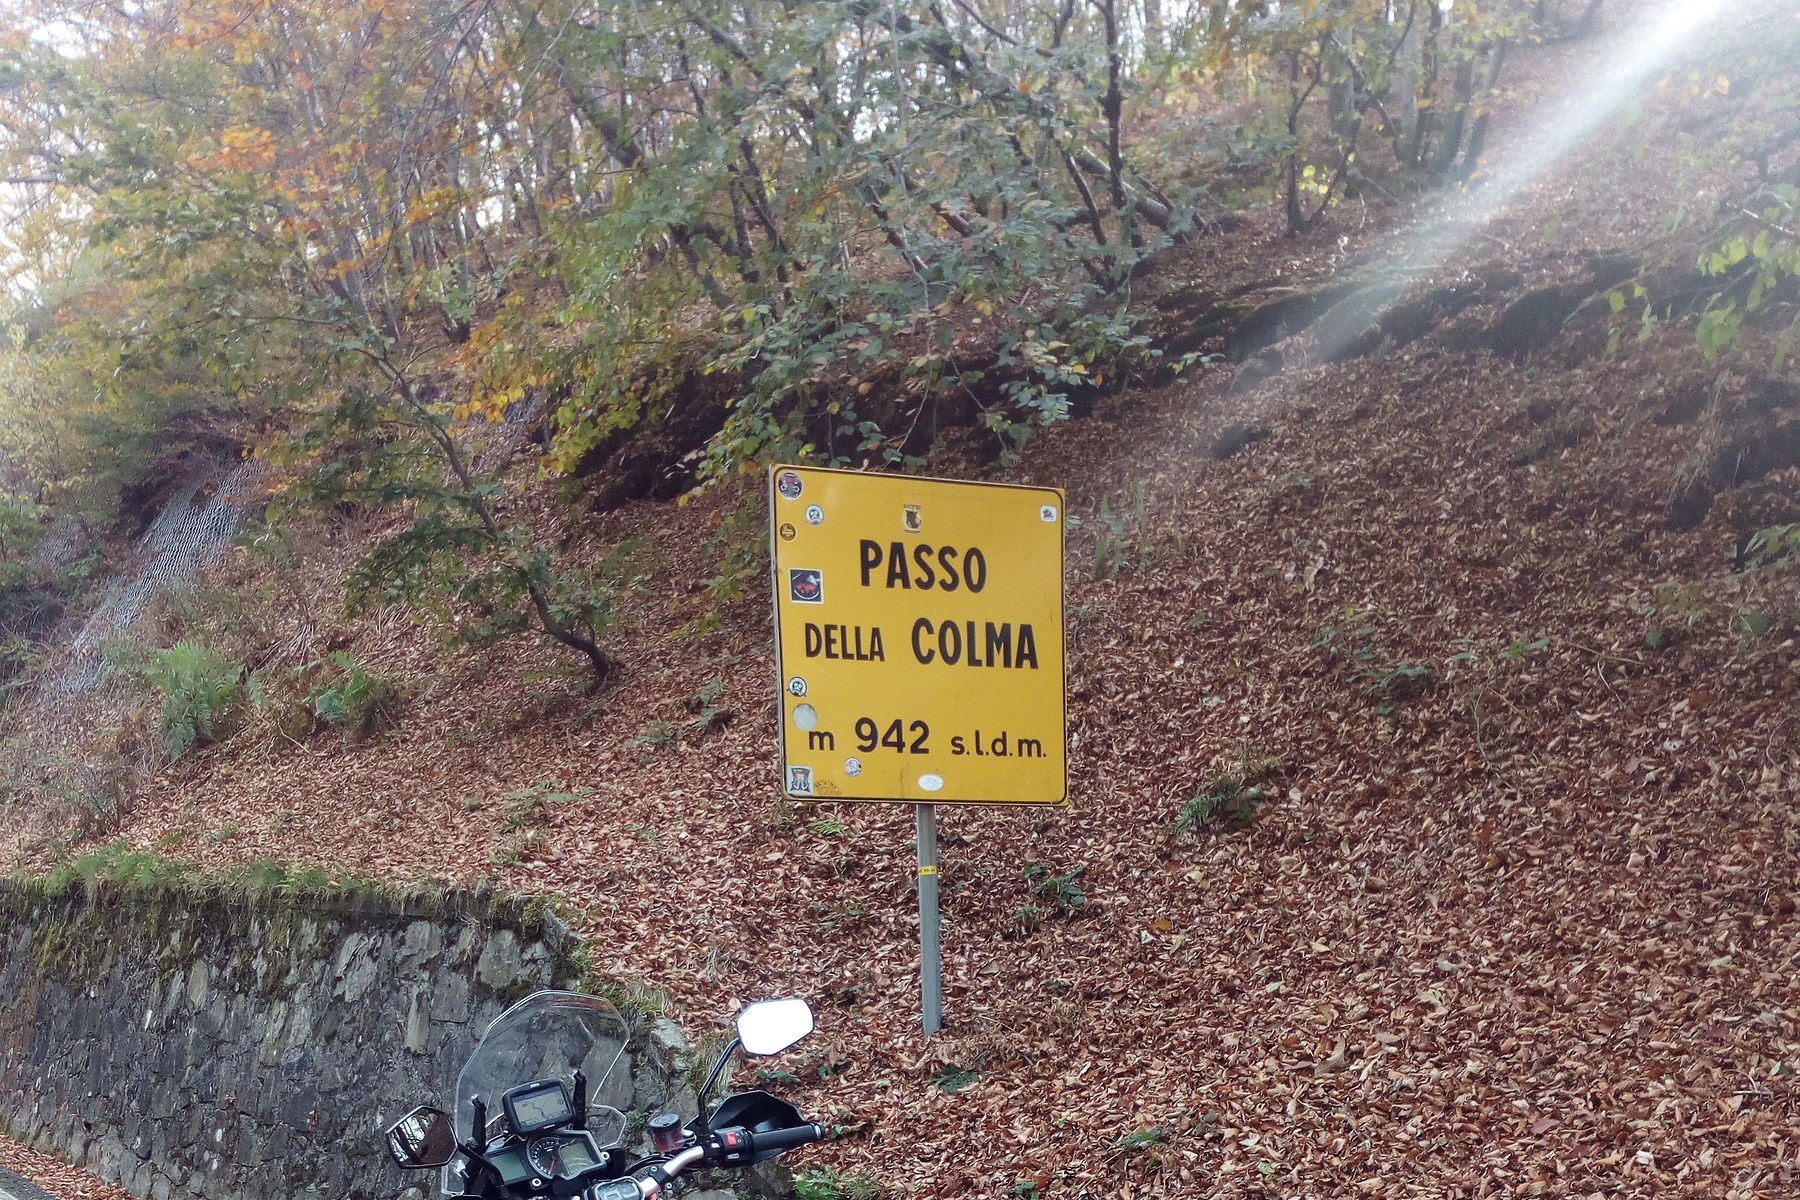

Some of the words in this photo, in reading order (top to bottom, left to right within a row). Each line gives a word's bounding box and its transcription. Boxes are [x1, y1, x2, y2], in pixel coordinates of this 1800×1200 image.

[859, 539, 987, 594] PASSO
[804, 623, 885, 661] DELLA
[911, 617, 1038, 669] COLMA
[808, 730, 834, 750] m
[854, 717, 930, 754] 942
[950, 730, 1047, 757] s.l.d.m.
